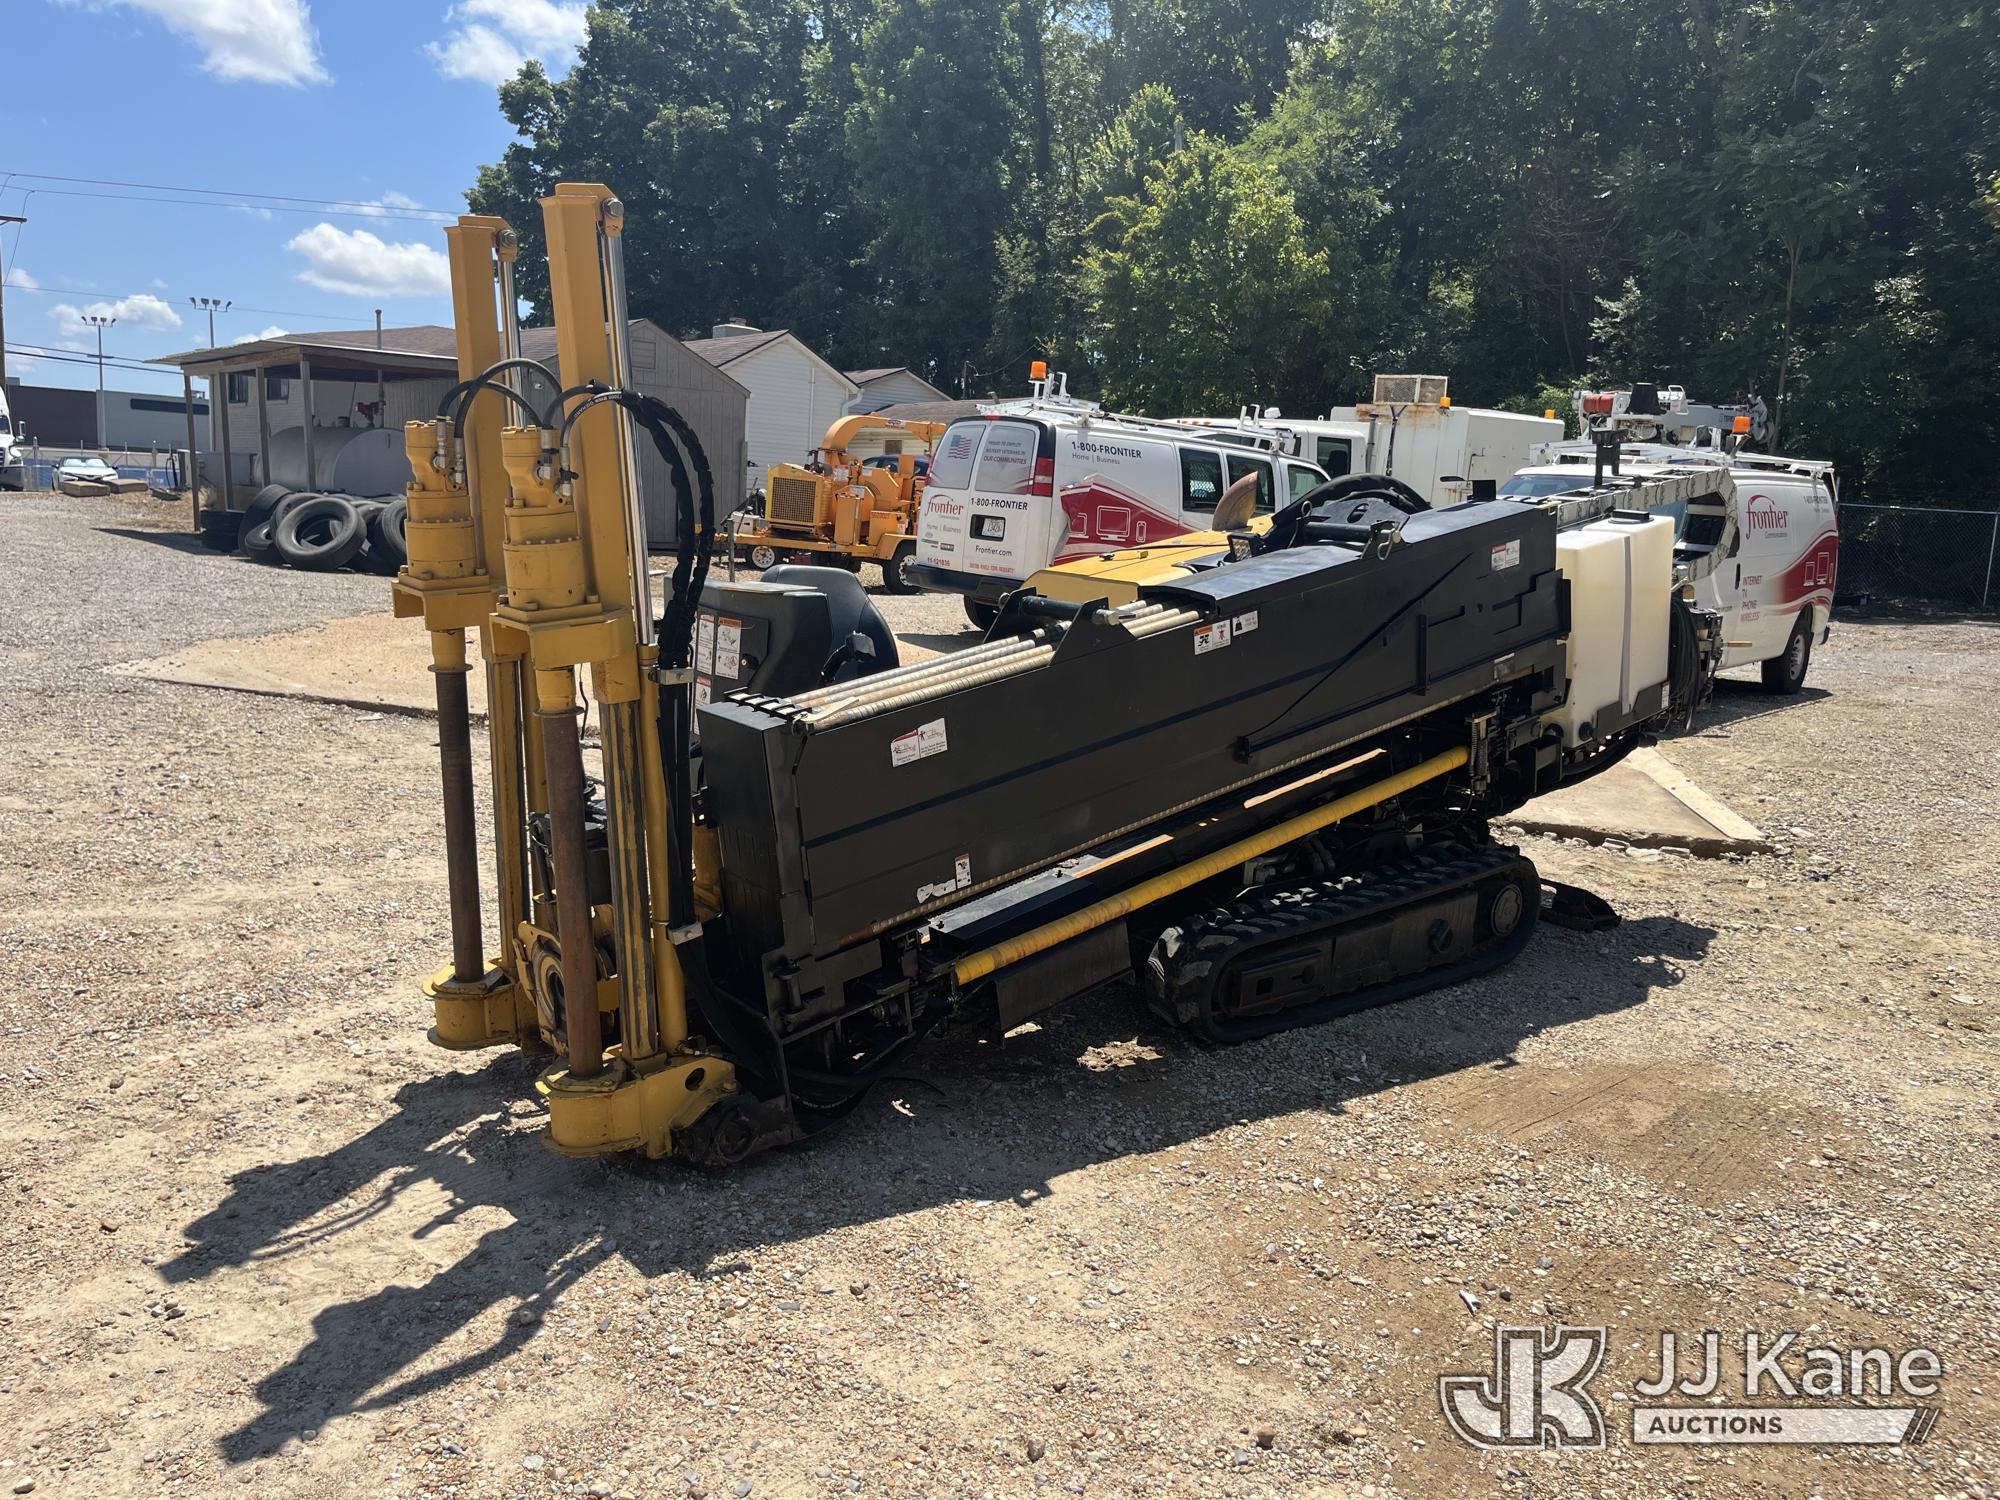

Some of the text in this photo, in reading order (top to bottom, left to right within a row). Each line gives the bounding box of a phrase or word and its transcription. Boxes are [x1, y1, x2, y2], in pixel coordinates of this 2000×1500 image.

[1071, 441, 1142, 459] 1-800-FRONTIER
[1072, 453, 1120, 464] Home Business
[925, 494, 964, 516] frontier
[970, 497, 1028, 511] 1-800-FRONTIER
[1746, 494, 1788, 539] frontier
[975, 545, 1012, 556] Frontier.com
